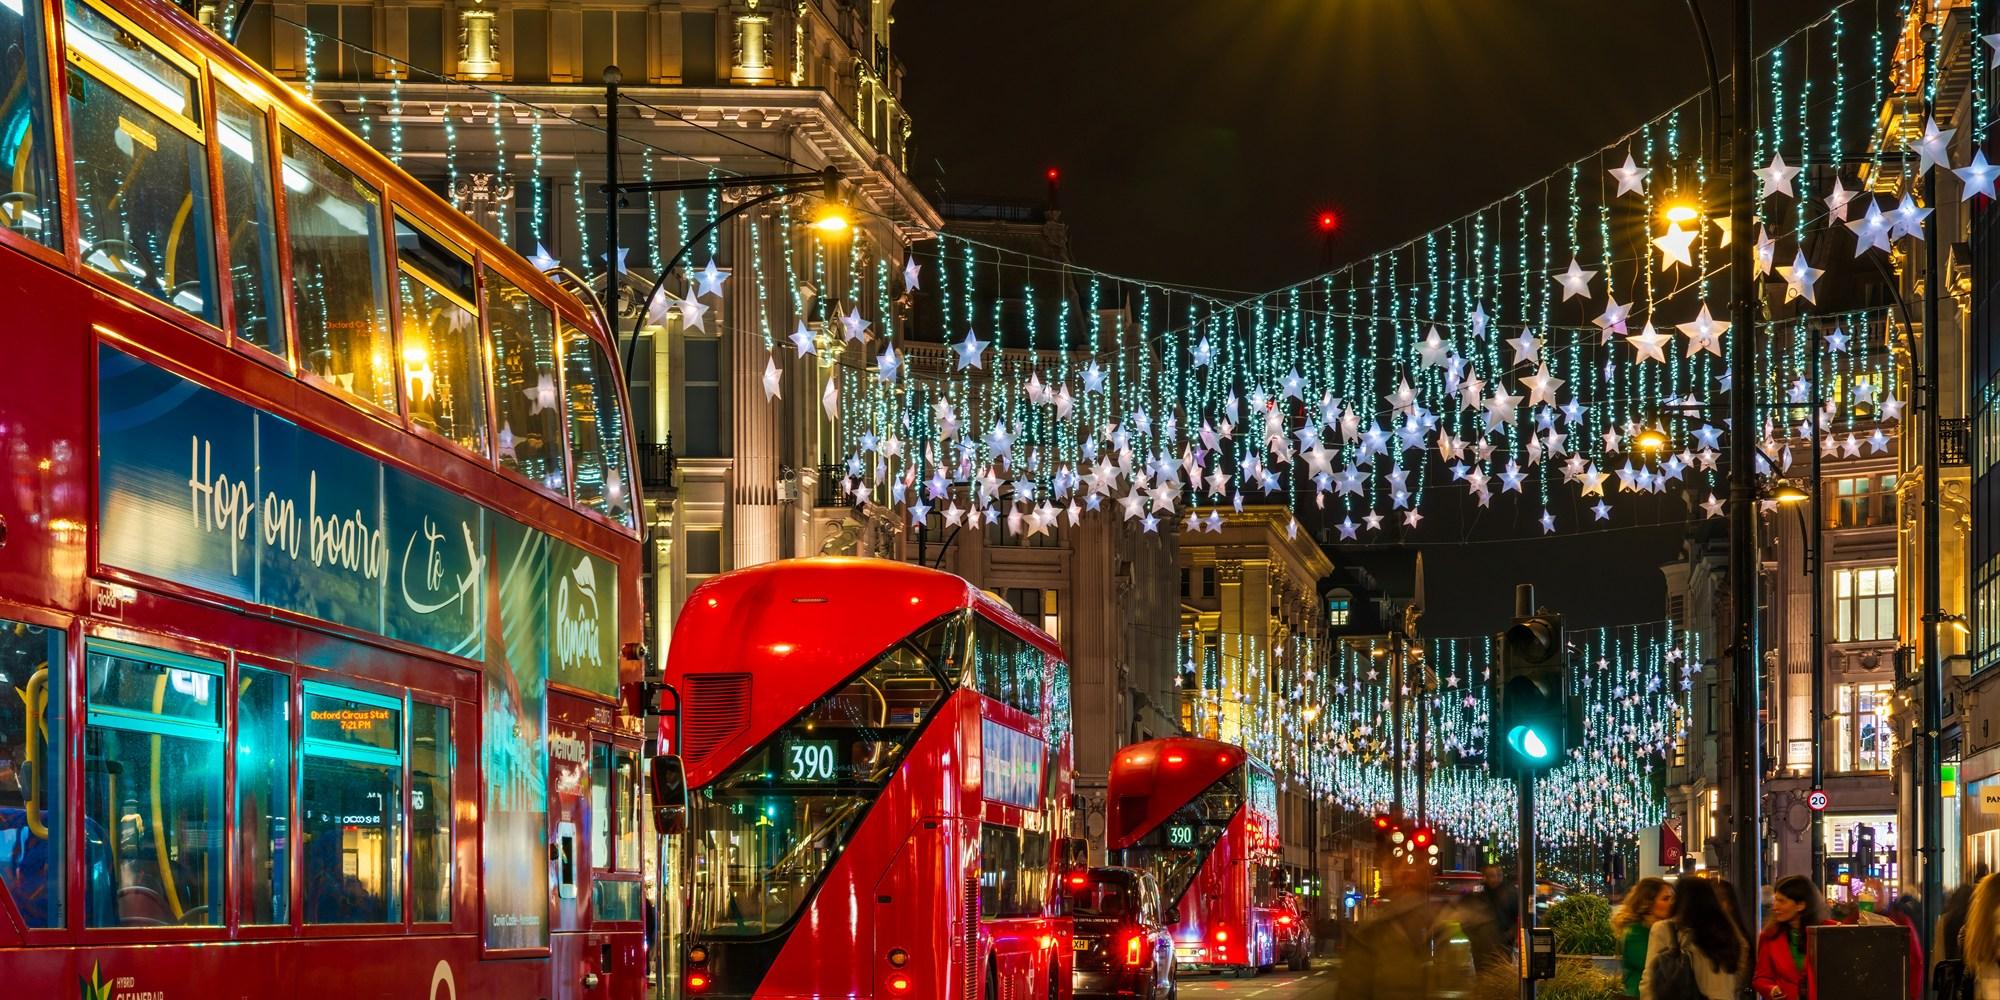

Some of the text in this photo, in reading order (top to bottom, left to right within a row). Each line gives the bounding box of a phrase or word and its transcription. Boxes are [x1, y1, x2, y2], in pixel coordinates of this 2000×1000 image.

[189, 435, 446, 592] Hop on board to
[96, 588, 117, 612] global
[556, 575, 602, 671] România
[310, 709, 389, 721] Oxford Circus Stat
[340, 721, 372, 730] 7:21 PM
[549, 727, 587, 763] Metroline
[791, 745, 834, 780] 390
[1811, 796, 1826, 805] 20
[1170, 827, 1192, 844] 390
[117, 977, 135, 988] HYBRID
